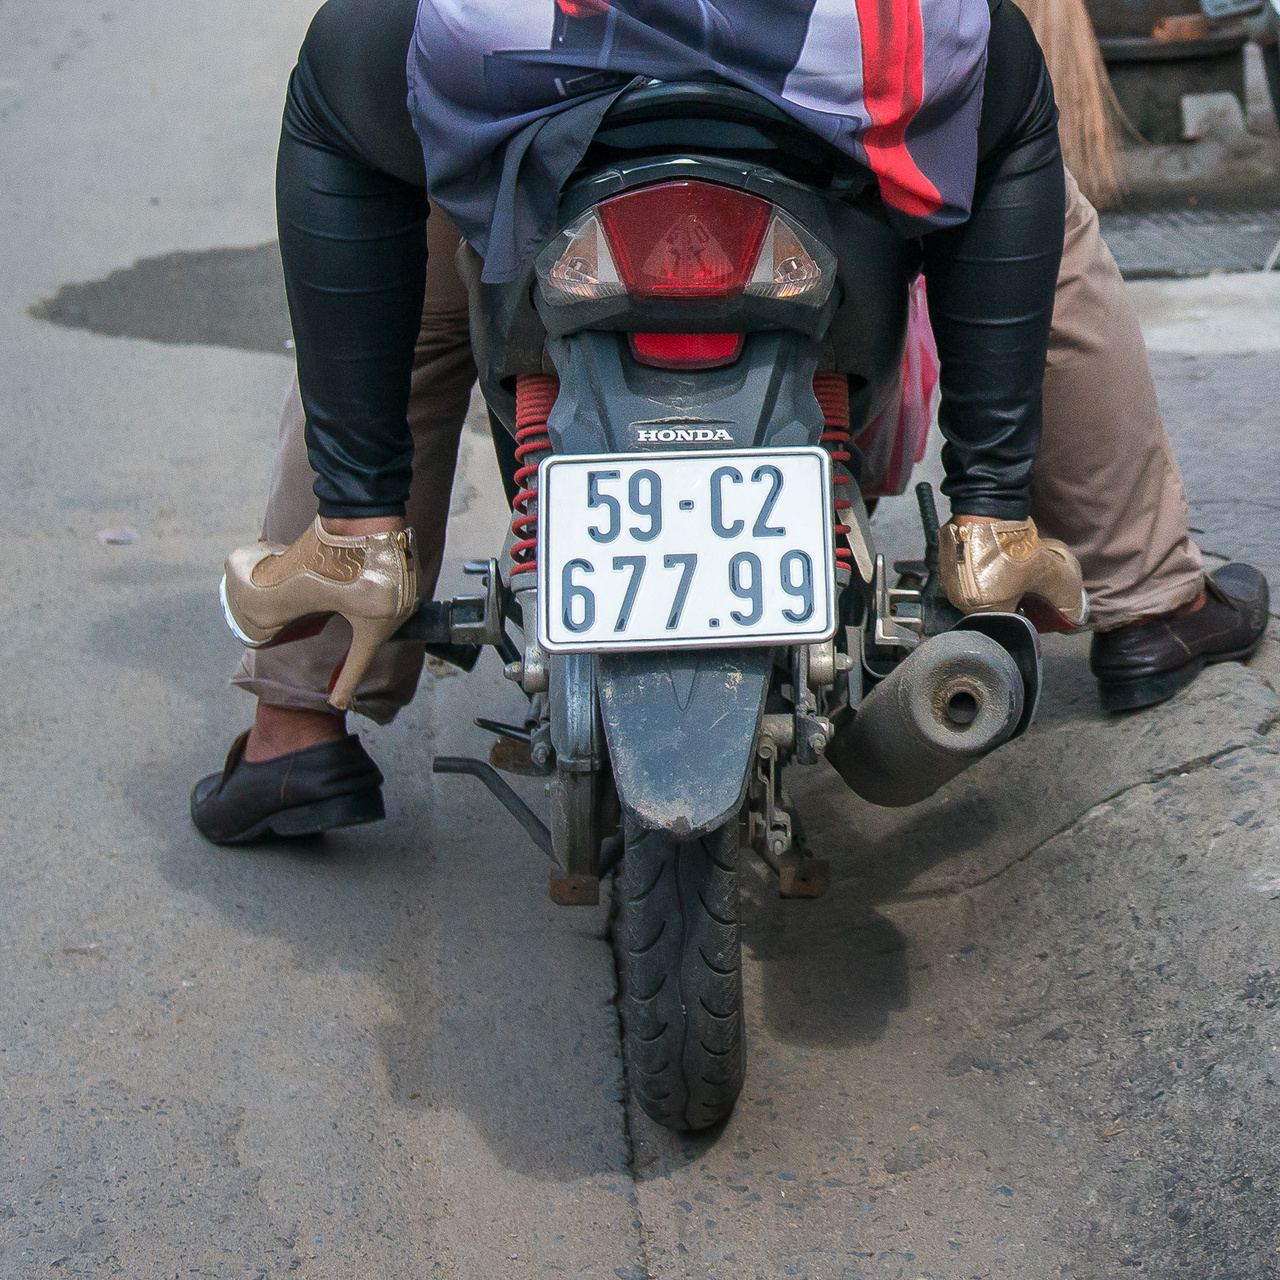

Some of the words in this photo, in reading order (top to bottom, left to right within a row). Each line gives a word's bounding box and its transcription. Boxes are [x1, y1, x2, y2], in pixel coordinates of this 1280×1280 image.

[637, 429, 734, 442] HONDA
[586, 464, 787, 544] 59-C2
[561, 549, 816, 634] 677.99
